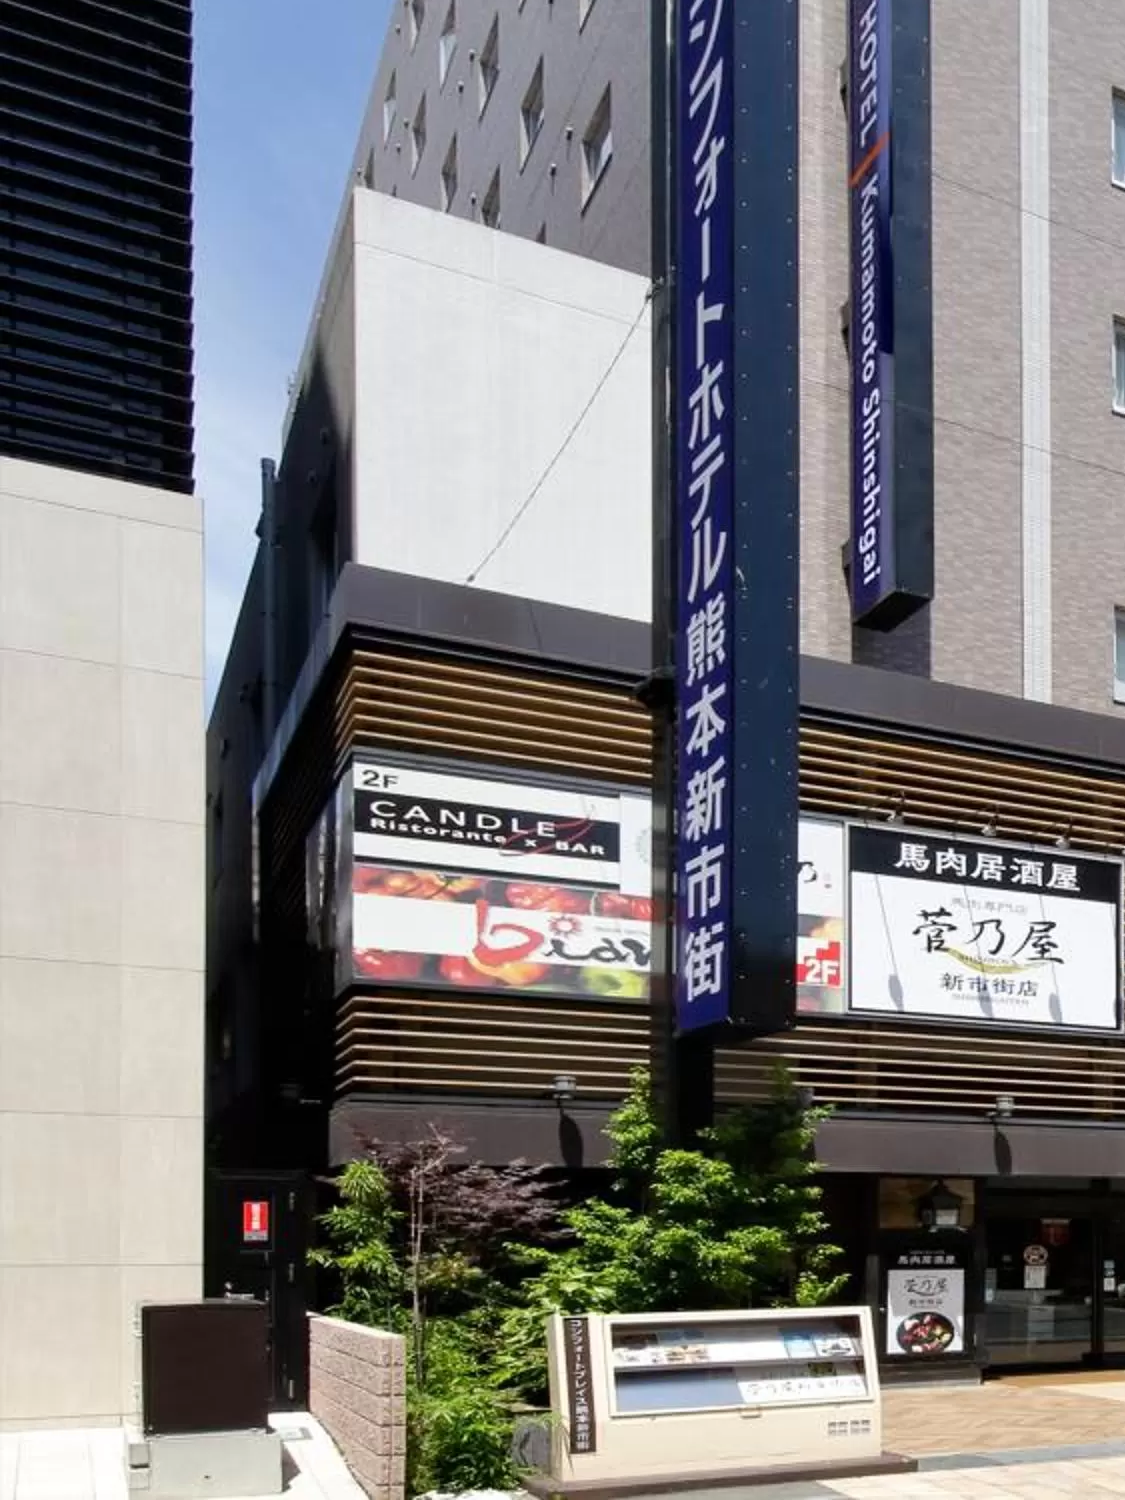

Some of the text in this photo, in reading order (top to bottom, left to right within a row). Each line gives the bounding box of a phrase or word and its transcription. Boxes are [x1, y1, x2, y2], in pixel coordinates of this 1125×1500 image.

[859, 0, 878, 148] HOTEL
[860, 173, 880, 384] Kumamoto
[859, 388, 881, 585] Shinshigai
[362, 769, 398, 789] 2F
[370, 801, 556, 838] CANDLE
[370, 818, 508, 847] Ristorante
[555, 841, 605, 855] BAR
[895, 842, 1081, 892] 馬肉居酒屋
[805, 957, 840, 984] 2F
[940, 972, 1039, 997] 新市街店
